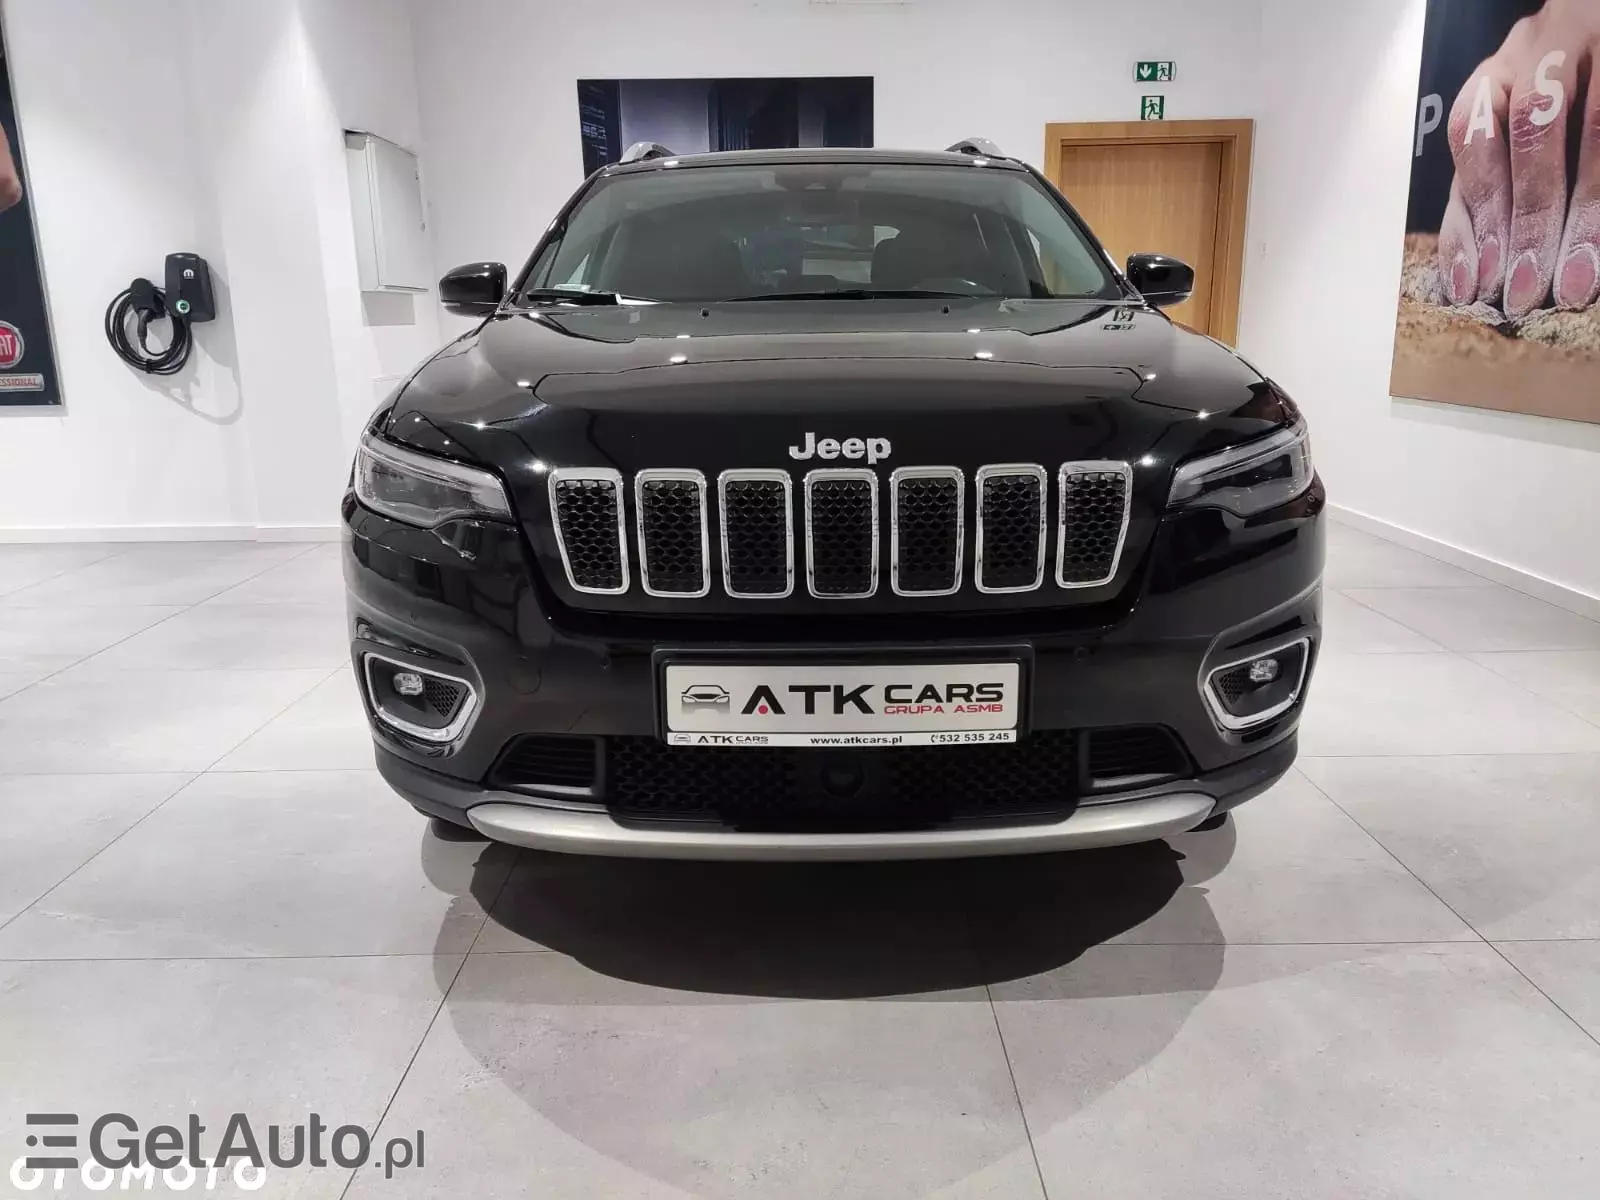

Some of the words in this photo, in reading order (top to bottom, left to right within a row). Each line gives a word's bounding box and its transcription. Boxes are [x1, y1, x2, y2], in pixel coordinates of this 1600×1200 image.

[788, 432, 892, 465] Jeep
[740, 685, 875, 715] ATK
[884, 683, 1004, 704] CARS
[884, 704, 945, 715] GRUPA
[953, 703, 1004, 713] ASMB
[697, 735, 734, 744] ATK
[810, 735, 903, 745] www.atkcars.pl
[939, 734, 961, 743] 532
[964, 733, 985, 742] 535
[989, 732, 1010, 741] 245
